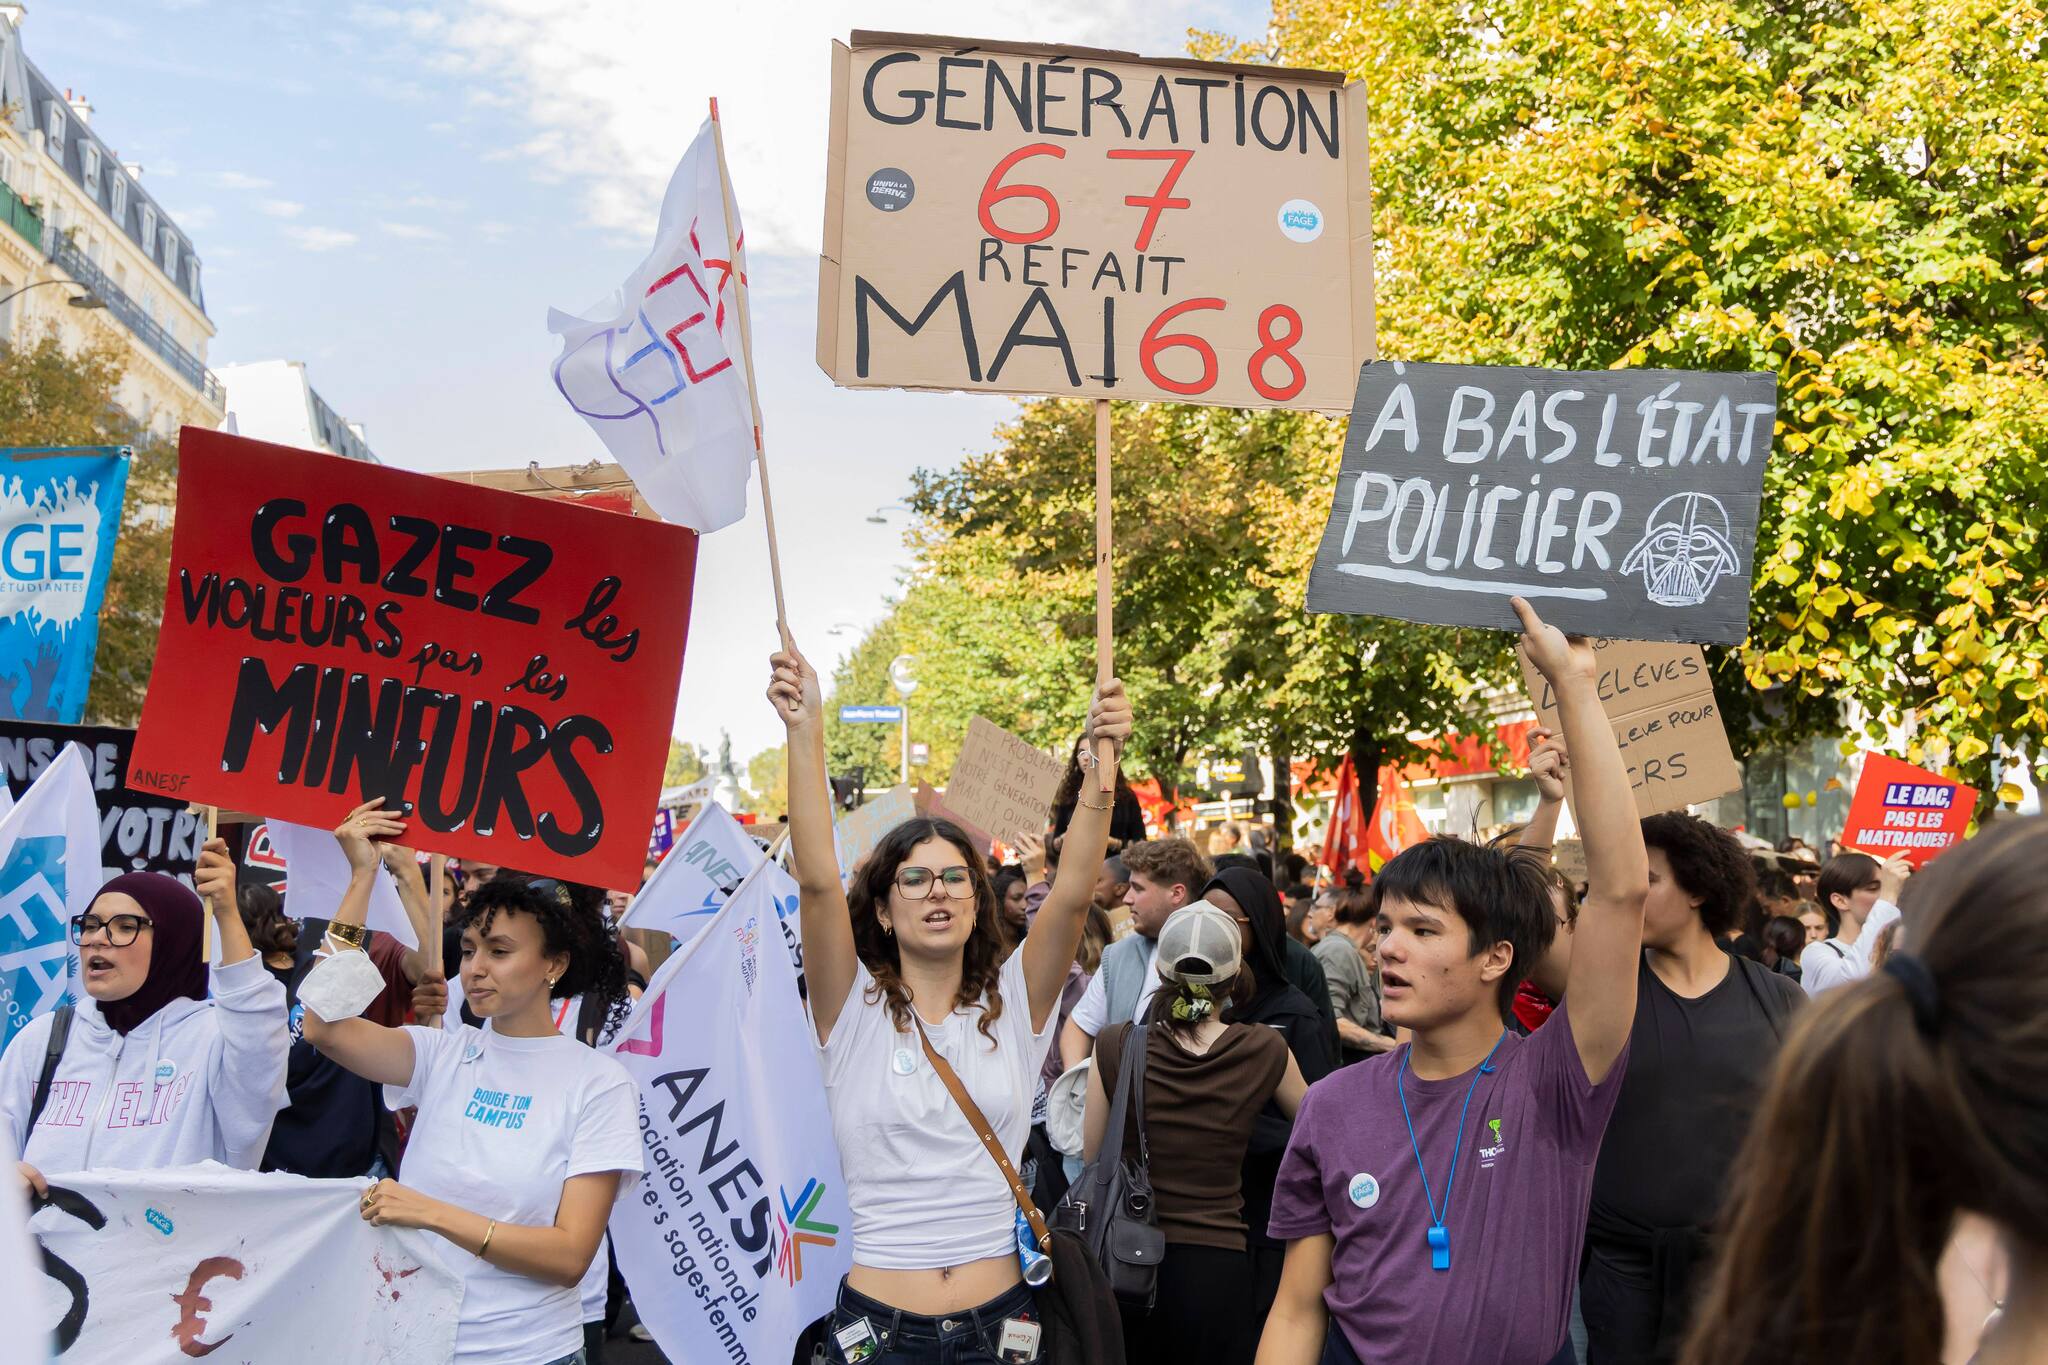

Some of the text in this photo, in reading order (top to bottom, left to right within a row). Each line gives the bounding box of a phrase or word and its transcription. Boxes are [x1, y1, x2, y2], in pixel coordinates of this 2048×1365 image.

[863, 46, 1340, 159] GÉNÉRATION
[1288, 215, 1314, 225] FAGE
[979, 238, 1186, 295] REFAIT
[855, 270, 1118, 388] MAI
[1365, 361, 1420, 453] À
[1442, 385, 1585, 464] BAS
[0, 523, 84, 582] GE
[1342, 472, 1622, 574] POLICIER
[251, 498, 640, 662] GAZEZ les
[180, 568, 568, 701] VIOLEURS pas les
[1667, 704, 1713, 730] POUR
[134, 768, 192, 792] ANESF
[221, 656, 614, 858] MINEURS
[1883, 810, 1945, 829] PAS LES
[1885, 784, 1951, 809] LE BAC,
[465, 1100, 527, 1130] CAMPUS
[473, 1087, 533, 1111] BOUGE TON
[638, 1094, 760, 1323] ociation nationale
